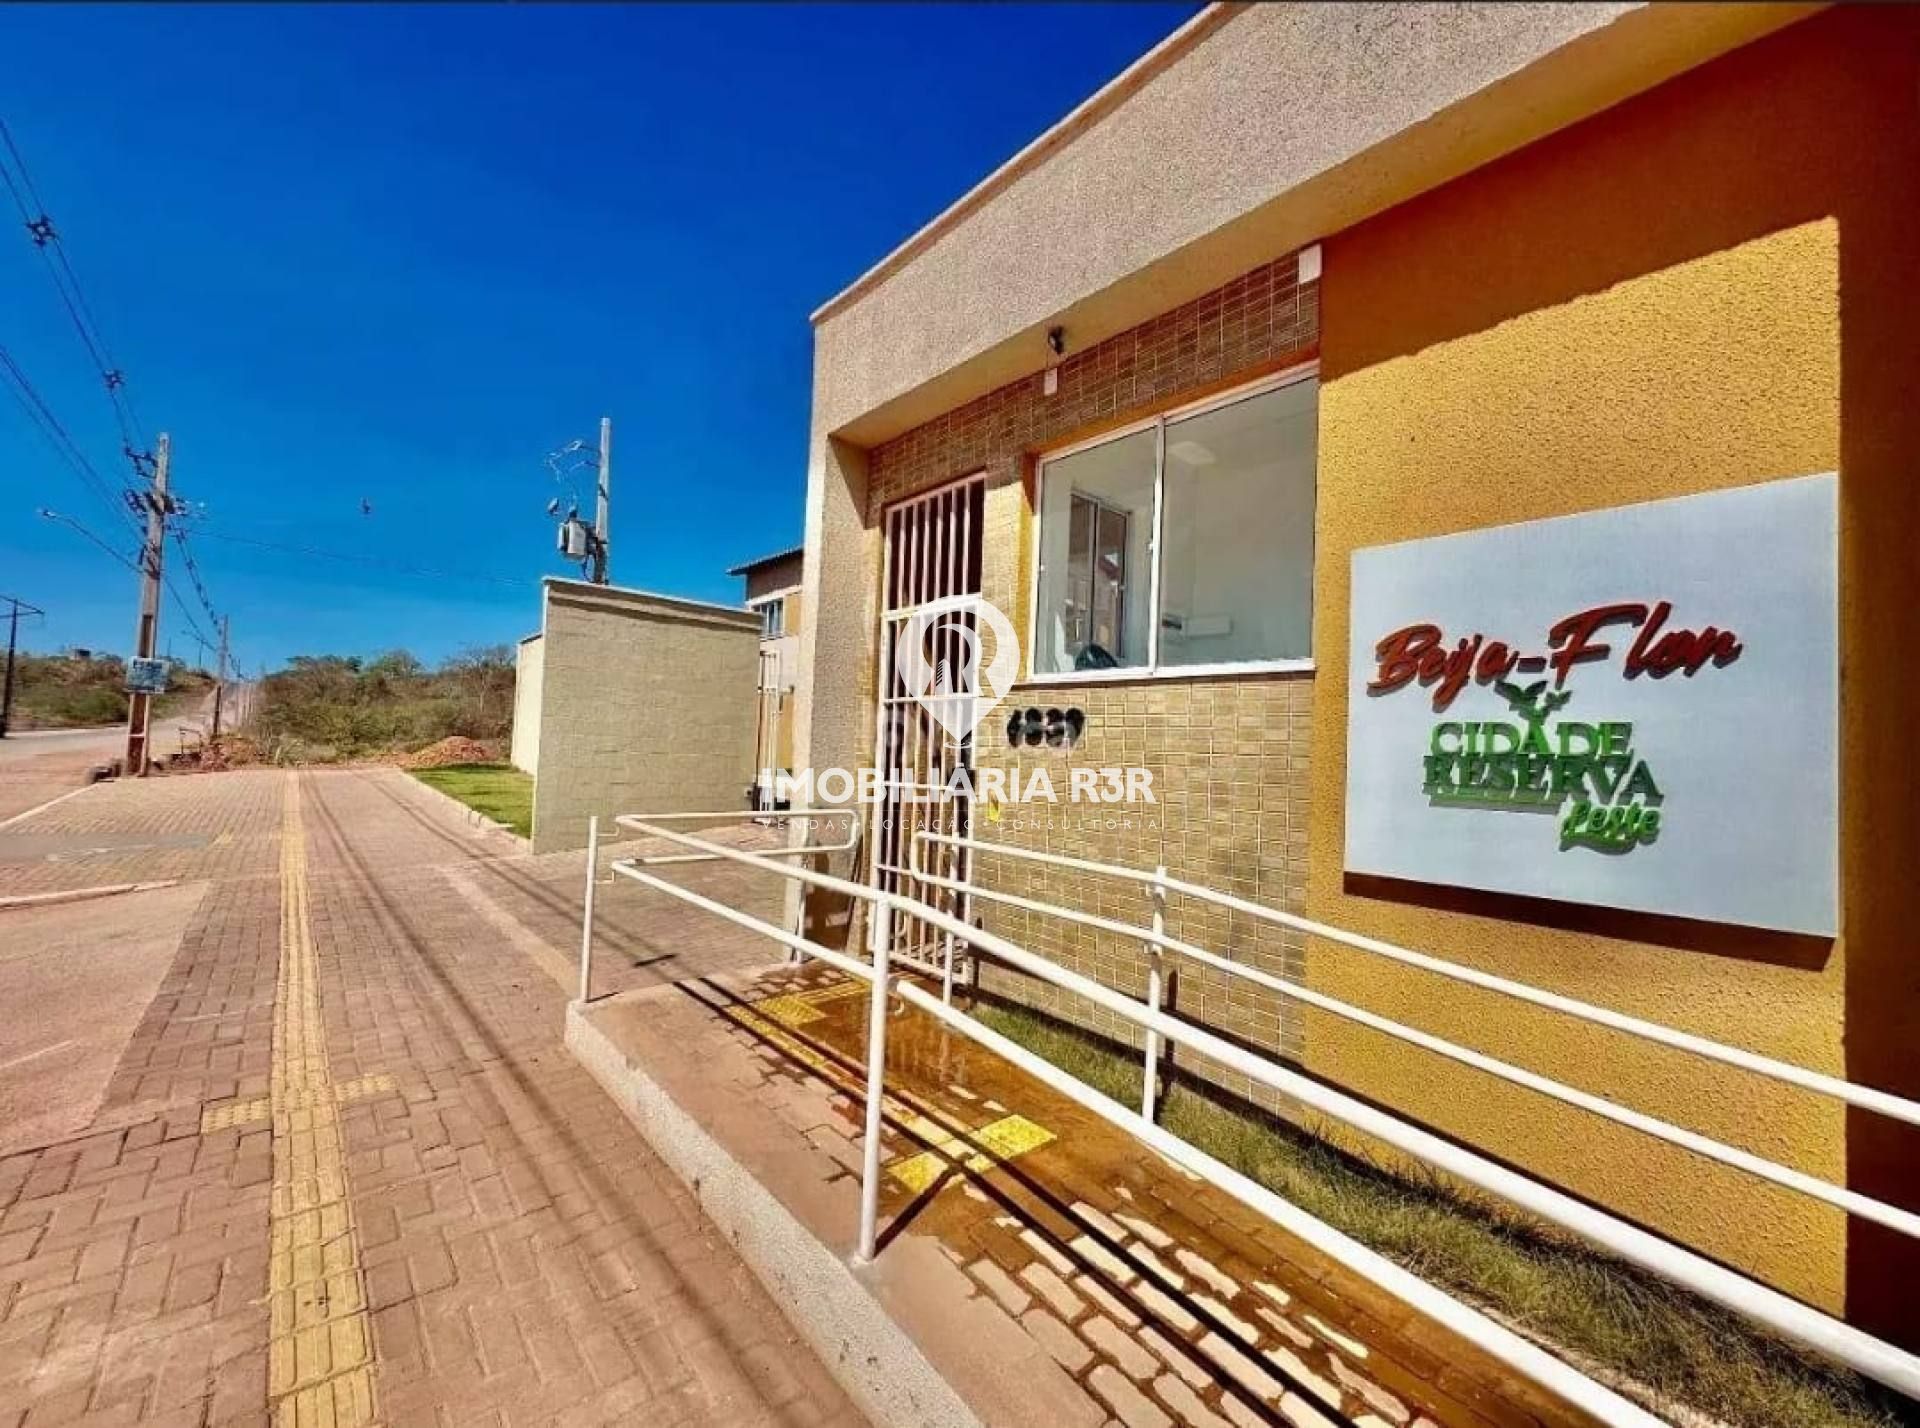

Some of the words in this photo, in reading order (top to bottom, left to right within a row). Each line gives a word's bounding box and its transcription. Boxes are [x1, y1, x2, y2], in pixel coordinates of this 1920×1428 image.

[1431, 720, 1632, 756] CIDADE
[1423, 752, 1664, 805] RESERVA
[1560, 800, 1661, 853] Leste
